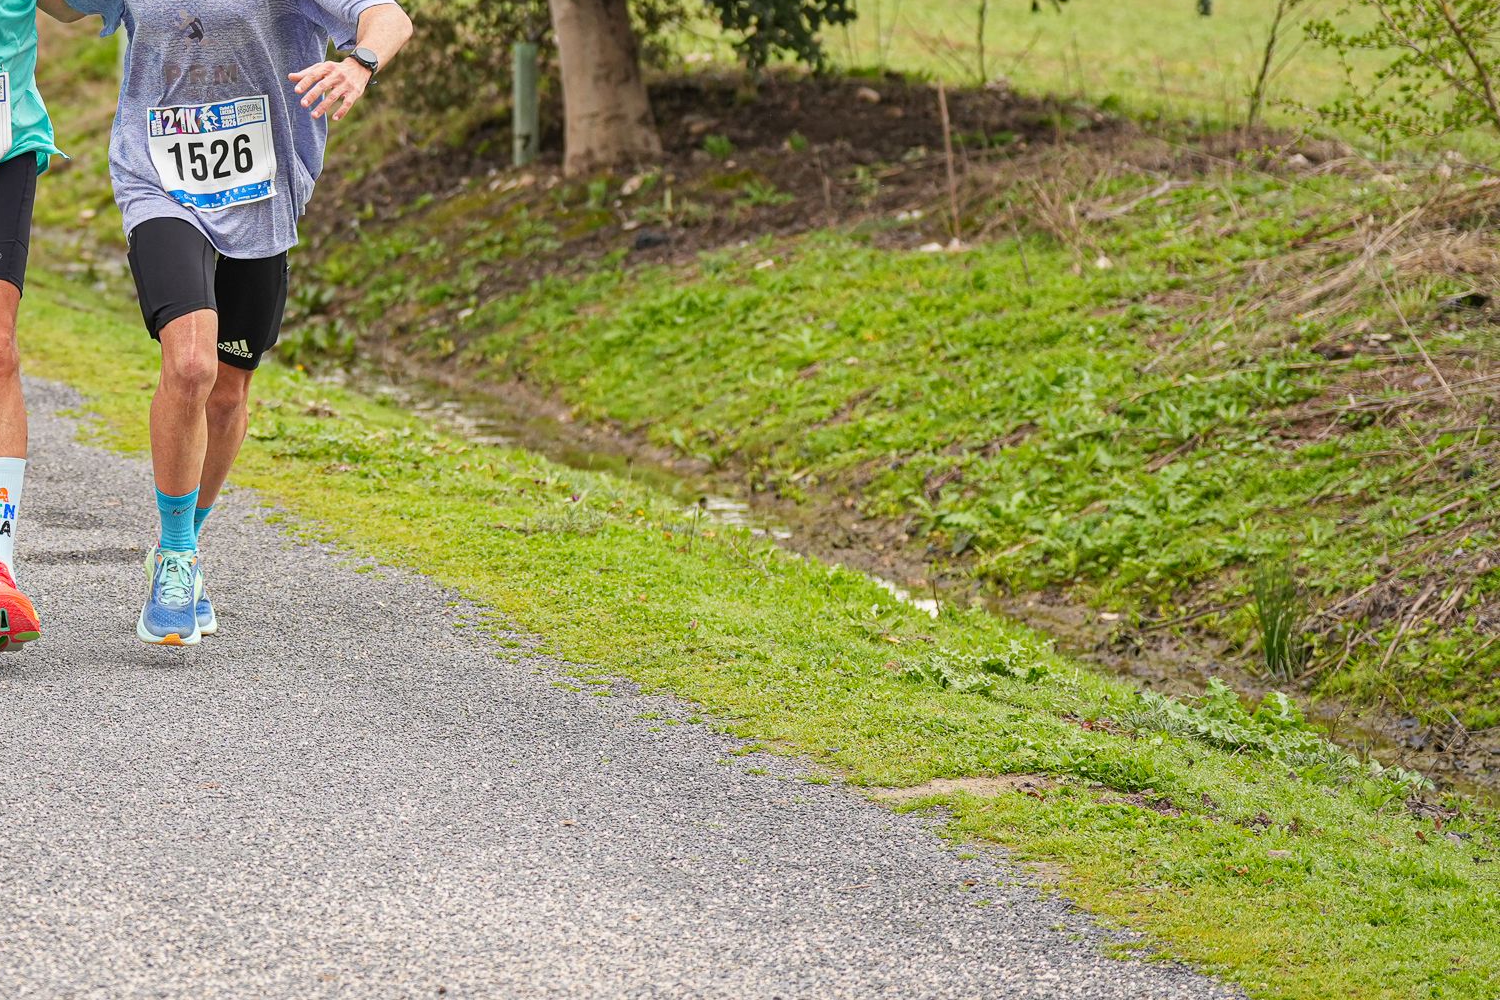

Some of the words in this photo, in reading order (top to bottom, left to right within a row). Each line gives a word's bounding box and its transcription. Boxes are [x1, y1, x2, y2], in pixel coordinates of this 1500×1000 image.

[162, 108, 200, 135] 21K
[167, 133, 254, 182] 1526
[217, 342, 253, 358] adidas
